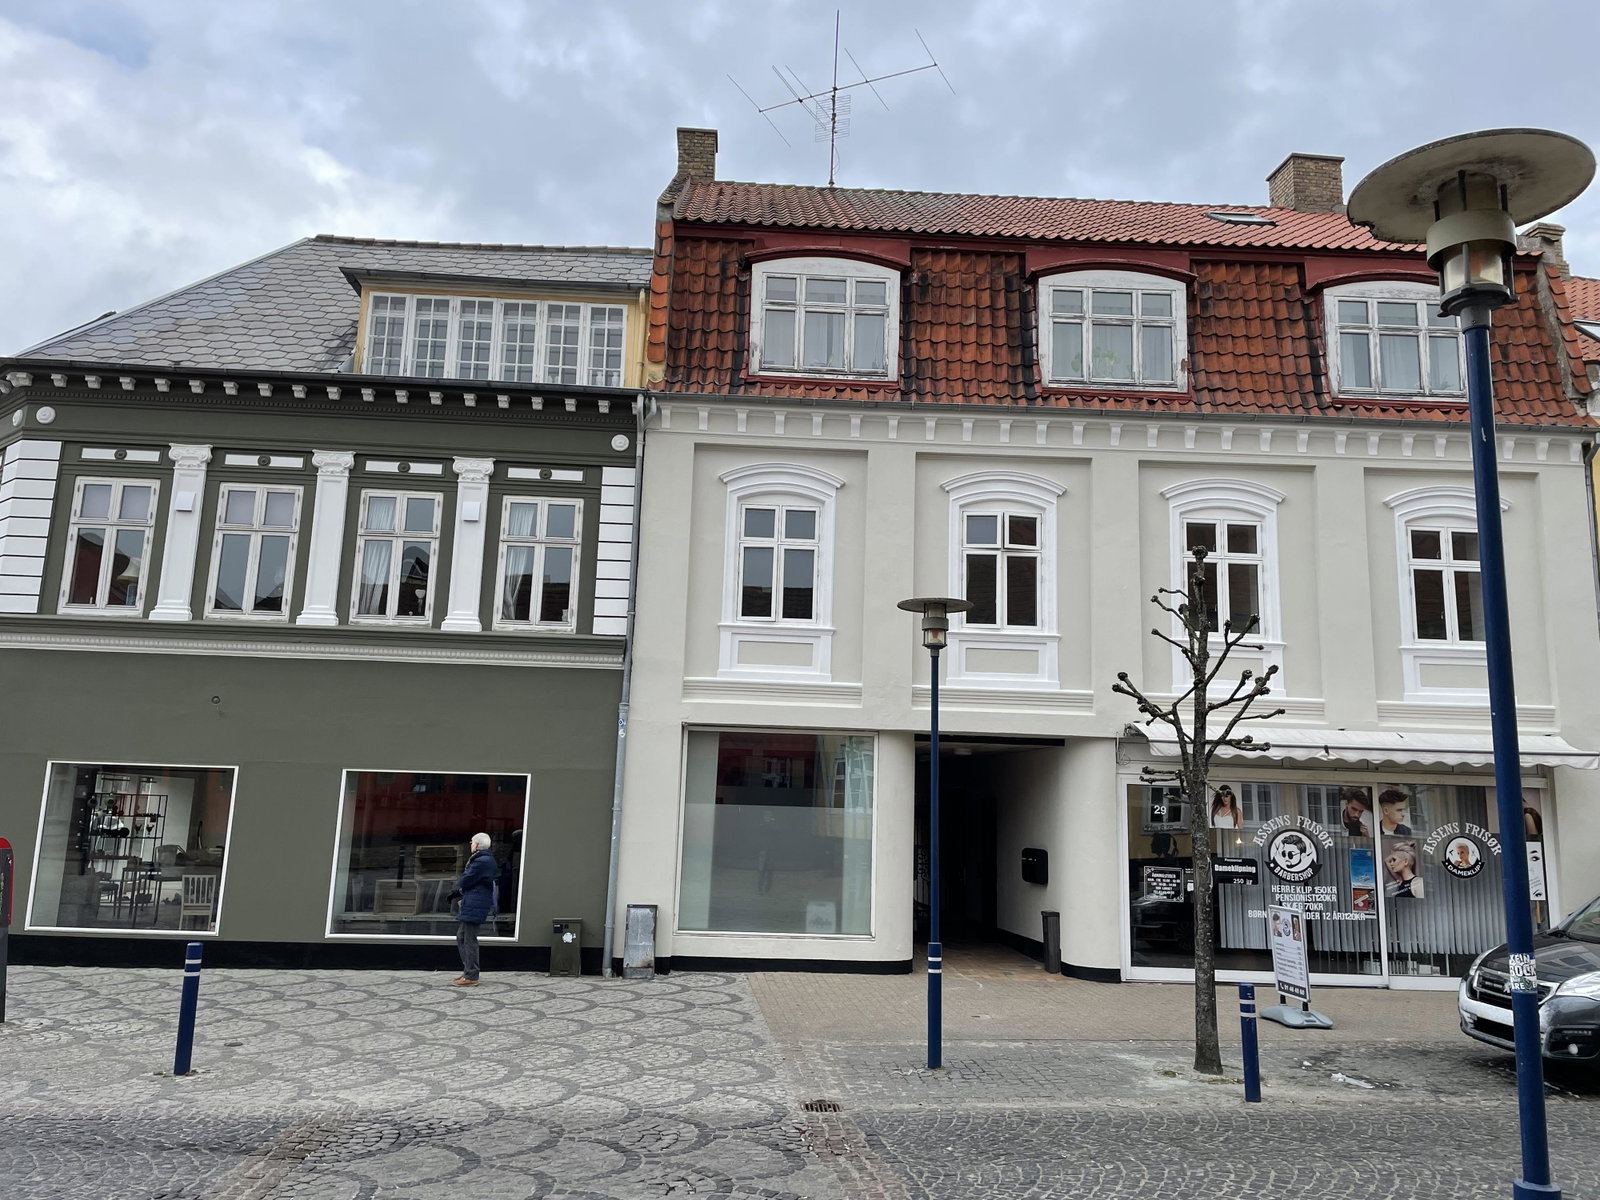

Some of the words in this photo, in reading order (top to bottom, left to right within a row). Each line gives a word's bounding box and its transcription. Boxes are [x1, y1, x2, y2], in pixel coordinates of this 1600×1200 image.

[1153, 804, 1167, 815] 29
[1252, 814, 1291, 847] ASSENS
[1296, 815, 1334, 849] FRISØR
[1422, 822, 1460, 855] ASSENS
[1465, 822, 1502, 856] FRISØR
[1273, 866, 1315, 882] BARBERSHOP
[1447, 864, 1481, 877] DAMEKLIP
[1322, 912, 1332, 920] 12
